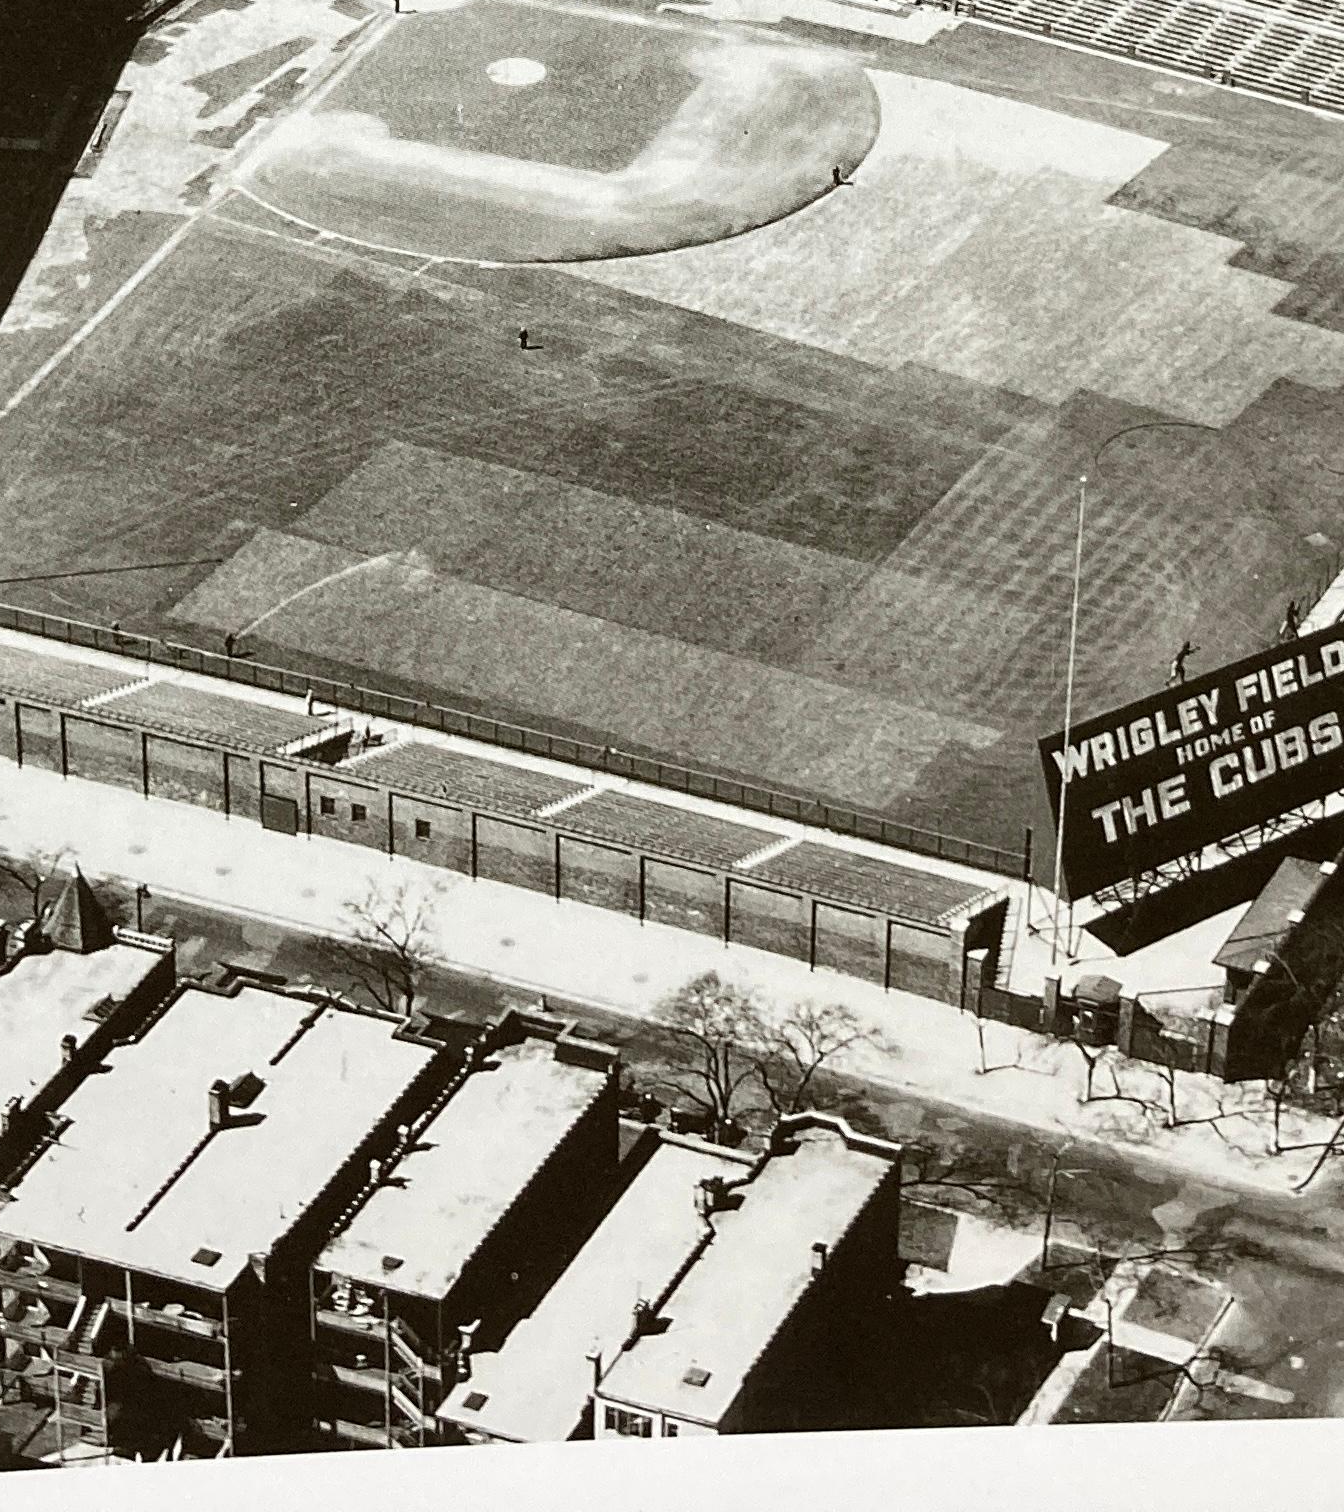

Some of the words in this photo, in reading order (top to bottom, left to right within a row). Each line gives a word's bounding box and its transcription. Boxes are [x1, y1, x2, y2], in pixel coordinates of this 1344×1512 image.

[1051, 688, 1219, 783] WRIGLEY
[1091, 773, 1191, 843] THE
[1208, 711, 1343, 799] CUBS
[1175, 722, 1246, 765] HOME
[1249, 710, 1276, 734] OF
